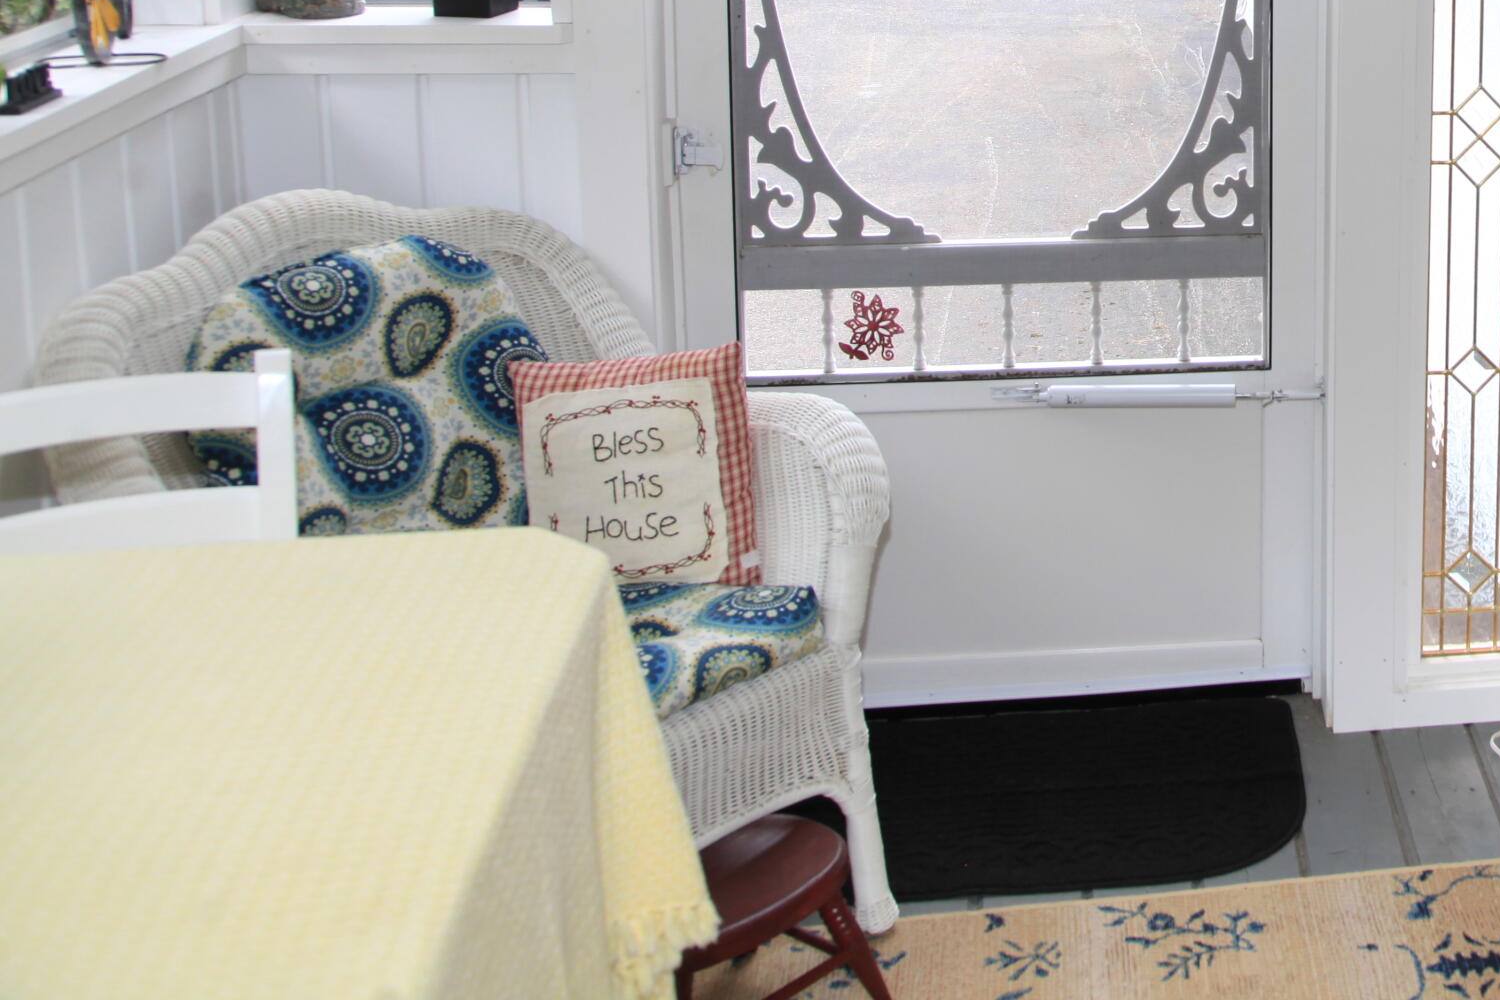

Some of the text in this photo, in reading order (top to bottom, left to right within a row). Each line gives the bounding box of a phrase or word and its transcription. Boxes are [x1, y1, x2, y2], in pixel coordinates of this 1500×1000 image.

[592, 427, 664, 462] Bless
[604, 470, 664, 504] This
[585, 512, 679, 543] House
